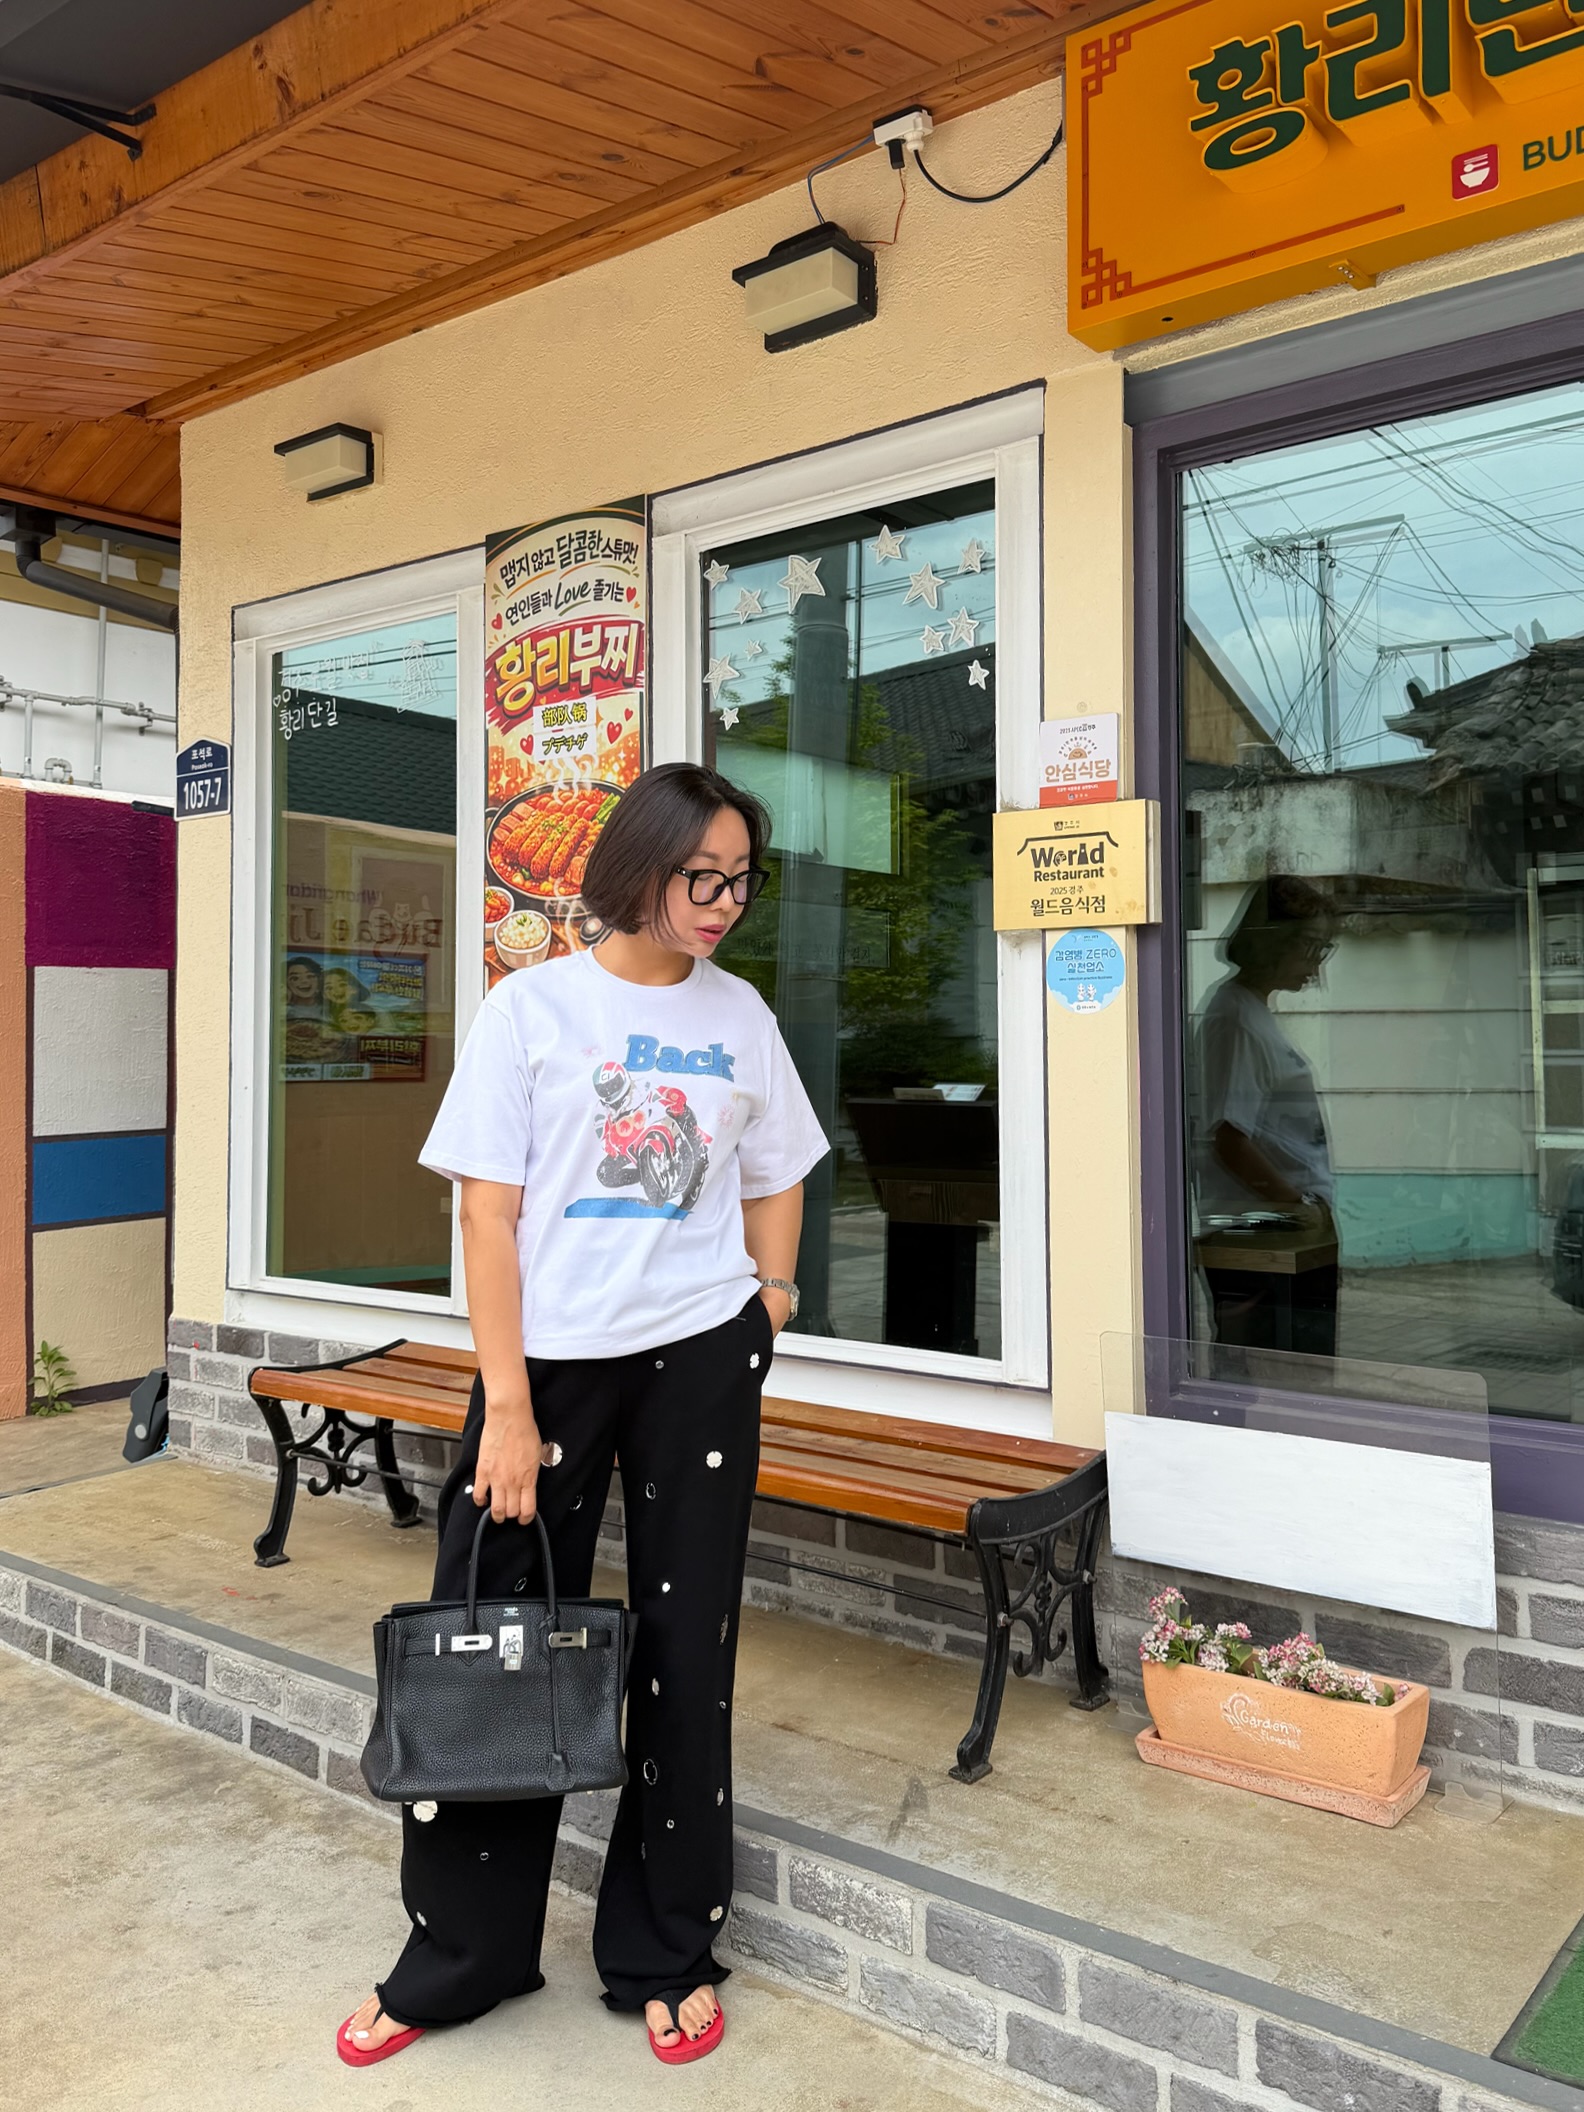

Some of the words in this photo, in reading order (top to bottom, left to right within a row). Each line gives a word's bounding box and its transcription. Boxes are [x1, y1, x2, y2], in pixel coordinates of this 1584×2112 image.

[500, 553, 530, 589] 맵지
[531, 547, 555, 572] 않고
[556, 529, 602, 569] 달콤한
[601, 538, 639, 564] 스튜맛!
[505, 588, 552, 626] 연인들과
[554, 581, 591, 610] Love
[593, 579, 624, 602] 즐기는
[495, 623, 639, 711] 황리부찌
[279, 698, 339, 740] 황리단길
[542, 702, 588, 727] 部队锅
[191, 747, 213, 760] 포석로
[1045, 759, 1111, 783] 안심식당
[184, 777, 221, 810] 1057-7
[1034, 866, 1104, 882] Restaurant
[1050, 887, 1067, 895] 2025
[1069, 885, 1084, 895] 경주
[1030, 895, 1105, 917] 월드음식점
[1056, 949, 1082, 961] 감염병
[1086, 948, 1117, 959] ZERO
[1067, 961, 1104, 973] 실천업소
[623, 1034, 735, 1083] Back
[1241, 1709, 1289, 1735] Garden
